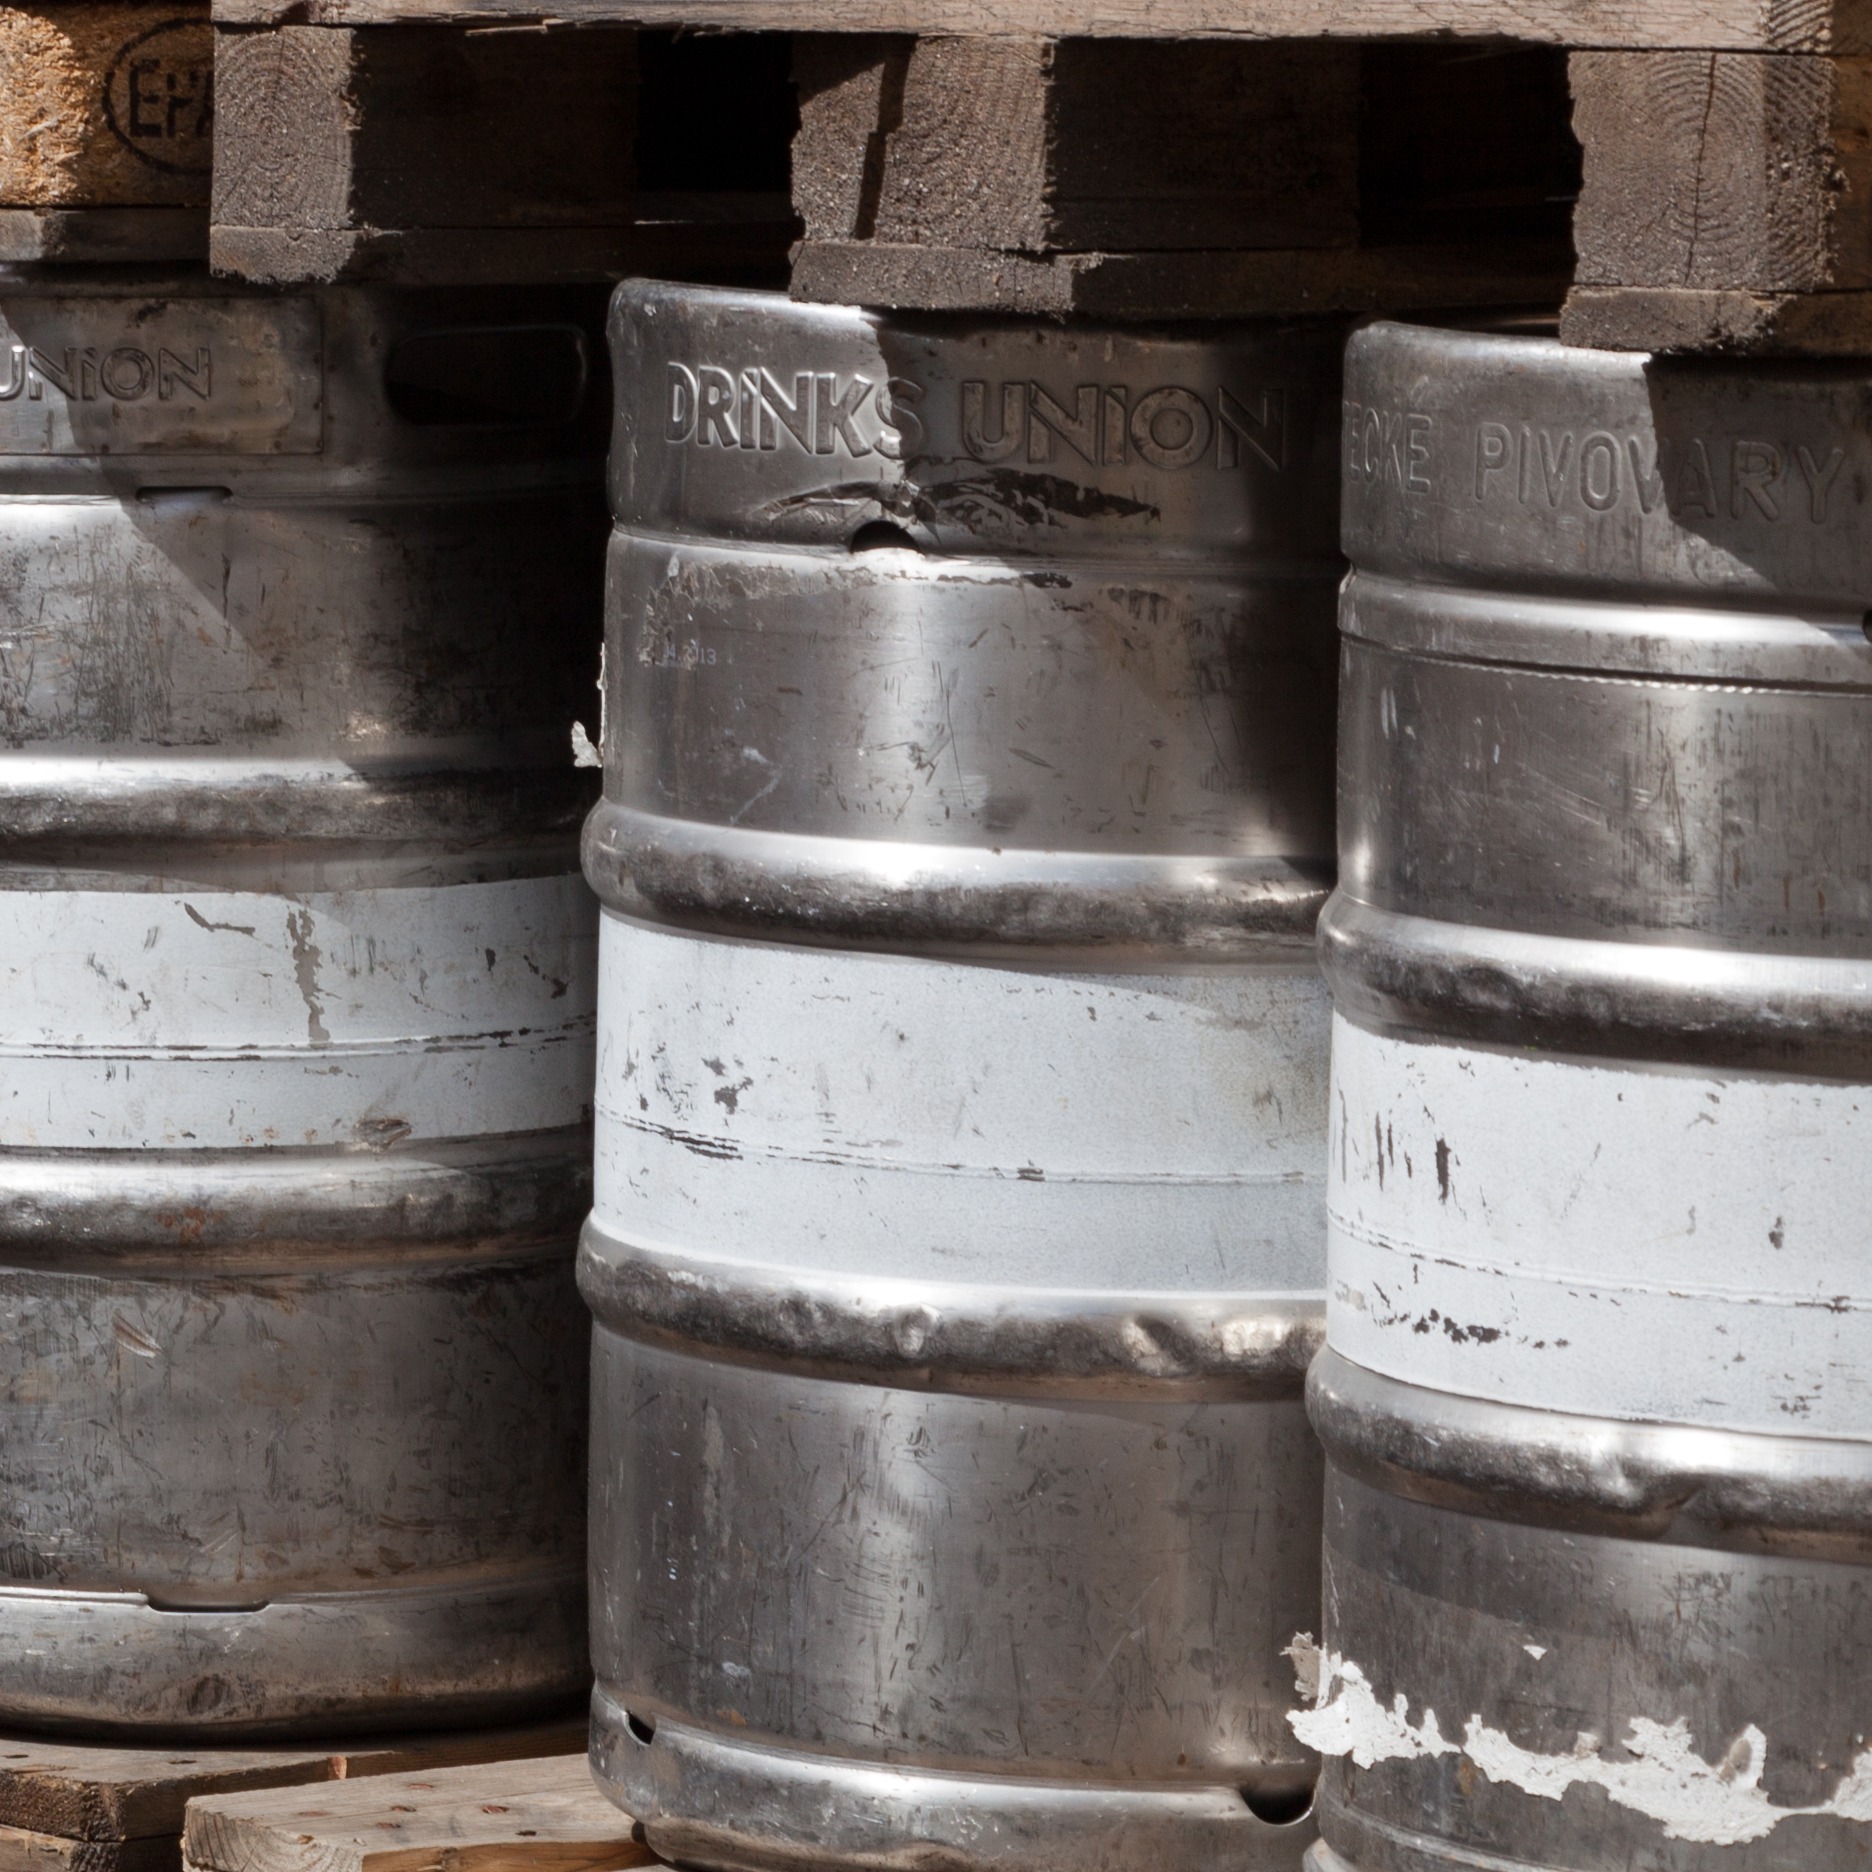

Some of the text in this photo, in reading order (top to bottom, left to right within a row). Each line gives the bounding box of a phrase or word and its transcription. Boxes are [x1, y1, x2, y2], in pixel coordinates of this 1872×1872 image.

[663, 360, 1287, 472] DRINKS UNION
[1474, 422, 1847, 525] PIVOVARY
